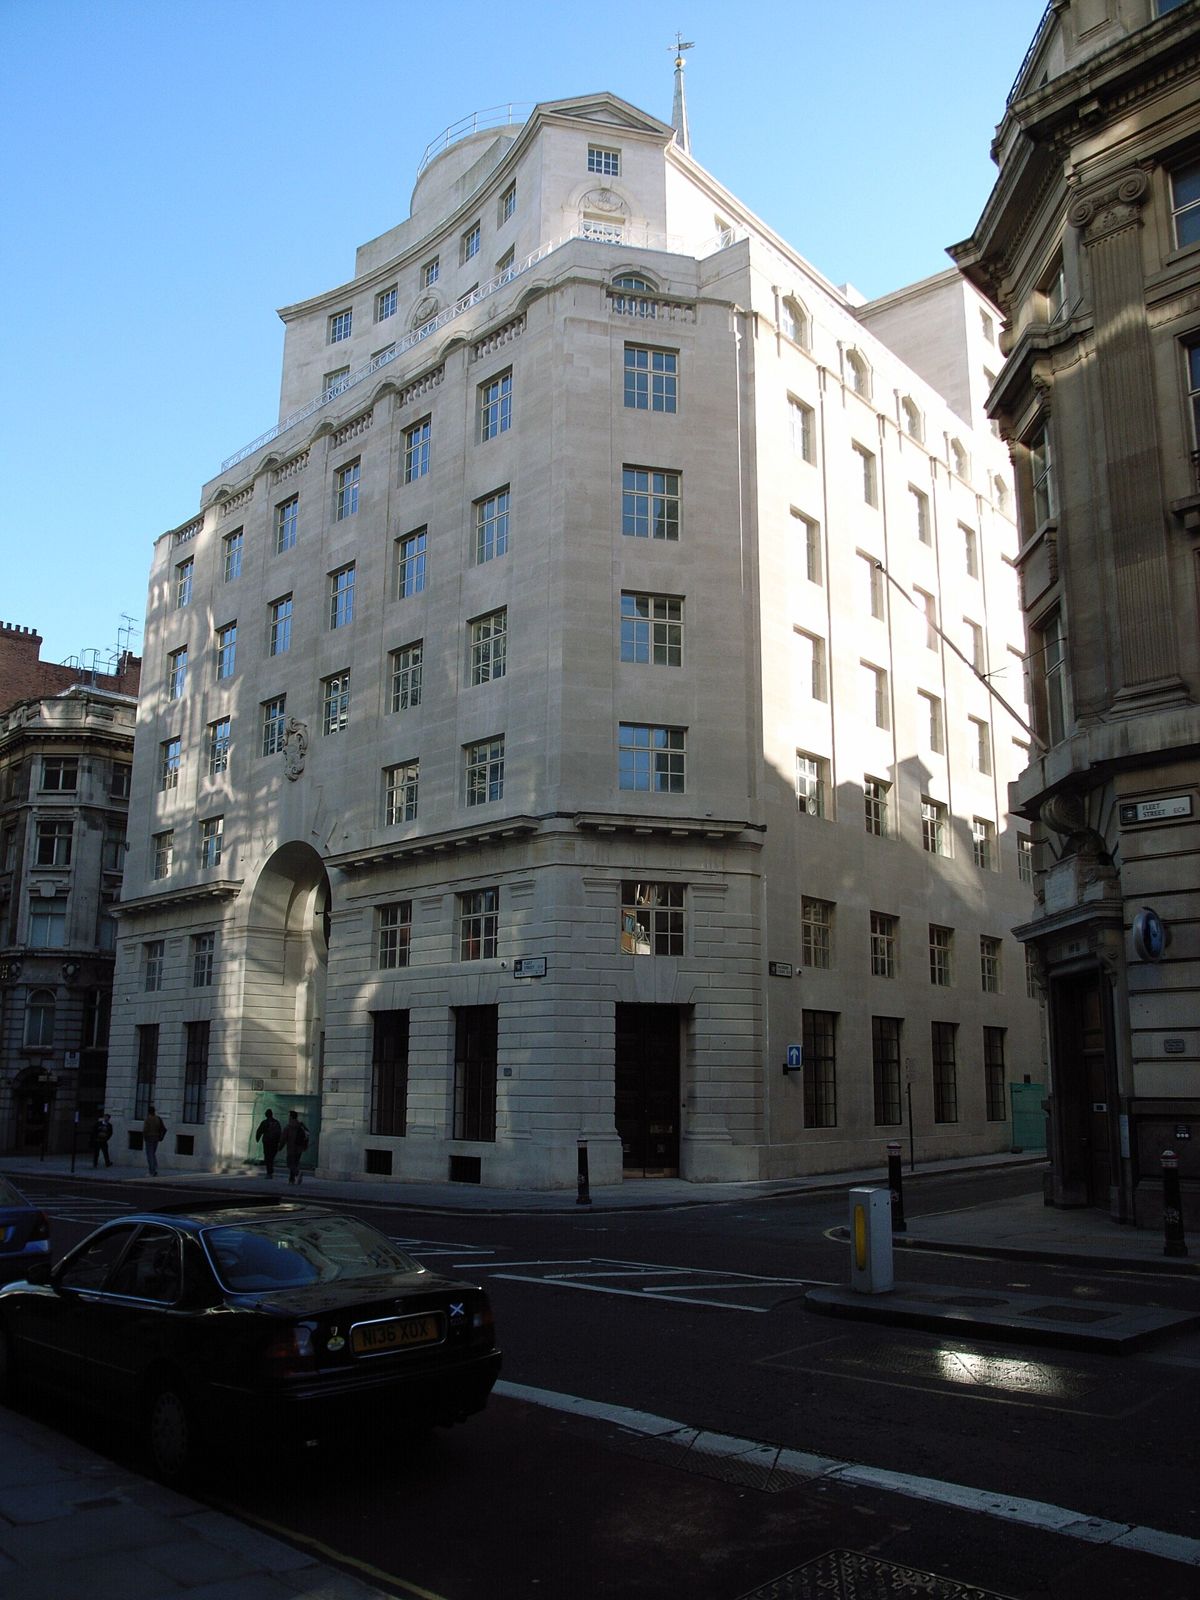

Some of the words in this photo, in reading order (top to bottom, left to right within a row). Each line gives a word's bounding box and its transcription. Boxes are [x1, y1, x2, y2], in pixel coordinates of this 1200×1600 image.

[1142, 803, 1160, 811] FLEET
[1142, 809, 1165, 818] STREET
[362, 1325, 396, 1347] N136
[400, 1319, 428, 1341] XOX
